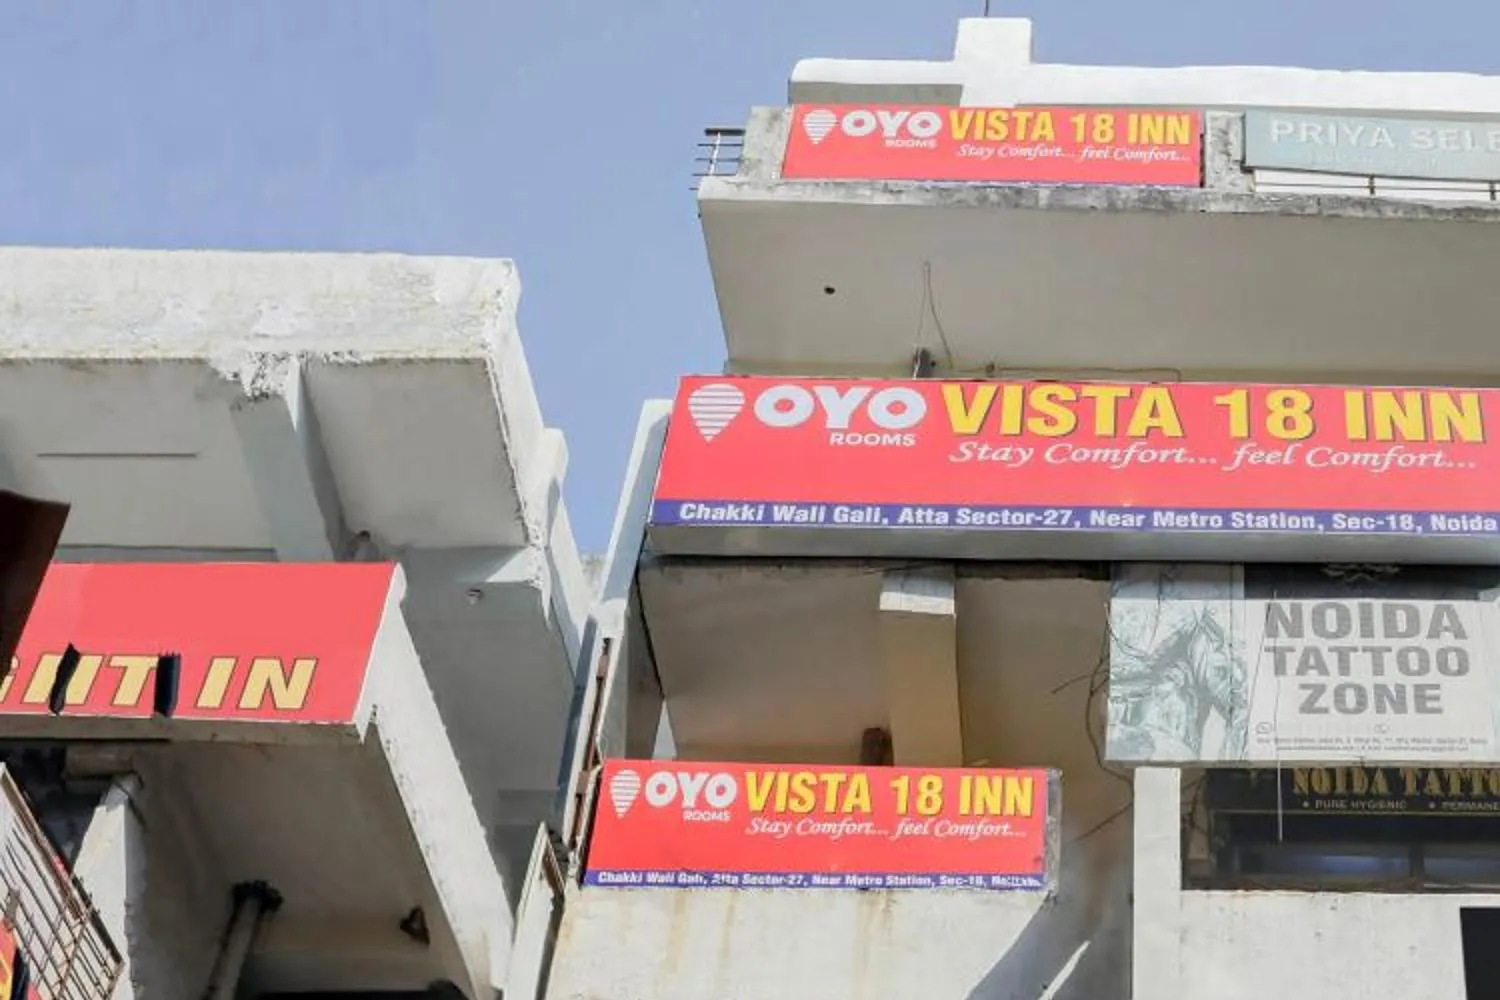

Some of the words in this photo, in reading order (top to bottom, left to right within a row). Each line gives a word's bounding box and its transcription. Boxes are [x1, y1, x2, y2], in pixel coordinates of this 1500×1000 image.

[841, 109, 943, 138] OYO
[948, 109, 1055, 143] VISTA
[1070, 112, 1116, 145] 18
[1127, 113, 1191, 146] INN
[1269, 118, 1396, 149] PRIYA
[956, 144, 996, 162] Stay
[1077, 145, 1112, 165] feel
[753, 384, 929, 430] OYO
[942, 383, 1185, 439] VISTA
[1213, 388, 1317, 441] 18
[1344, 390, 1488, 443] INN
[828, 432, 917, 447] ROOMS
[948, 441, 1034, 468] Stay
[1221, 442, 1300, 472] feel
[678, 502, 766, 522] Chakki
[772, 504, 827, 524] Wali
[832, 504, 890, 527] Gali,
[897, 508, 950, 526] Atta
[955, 508, 1081, 529] Sector-27,
[1089, 509, 1145, 528] Near
[1152, 510, 1224, 530] Metro
[1229, 510, 1326, 532] Station,
[1331, 512, 1424, 534] Sec-18,
[1428, 512, 1498, 533] Noida
[1264, 600, 1469, 640] NOIDA
[1263, 644, 1471, 678] TATTOO
[1298, 682, 1445, 716] ZONE
[645, 771, 738, 808] OYO
[744, 772, 872, 815] VISTA
[890, 775, 943, 816] 18
[958, 775, 1036, 818] INN
[1291, 767, 1393, 797] NOIDA
[683, 810, 731, 822] ROOMS
[1314, 799, 1348, 811] PURE
[745, 818, 790, 839] Stay
[890, 818, 931, 841] feel
